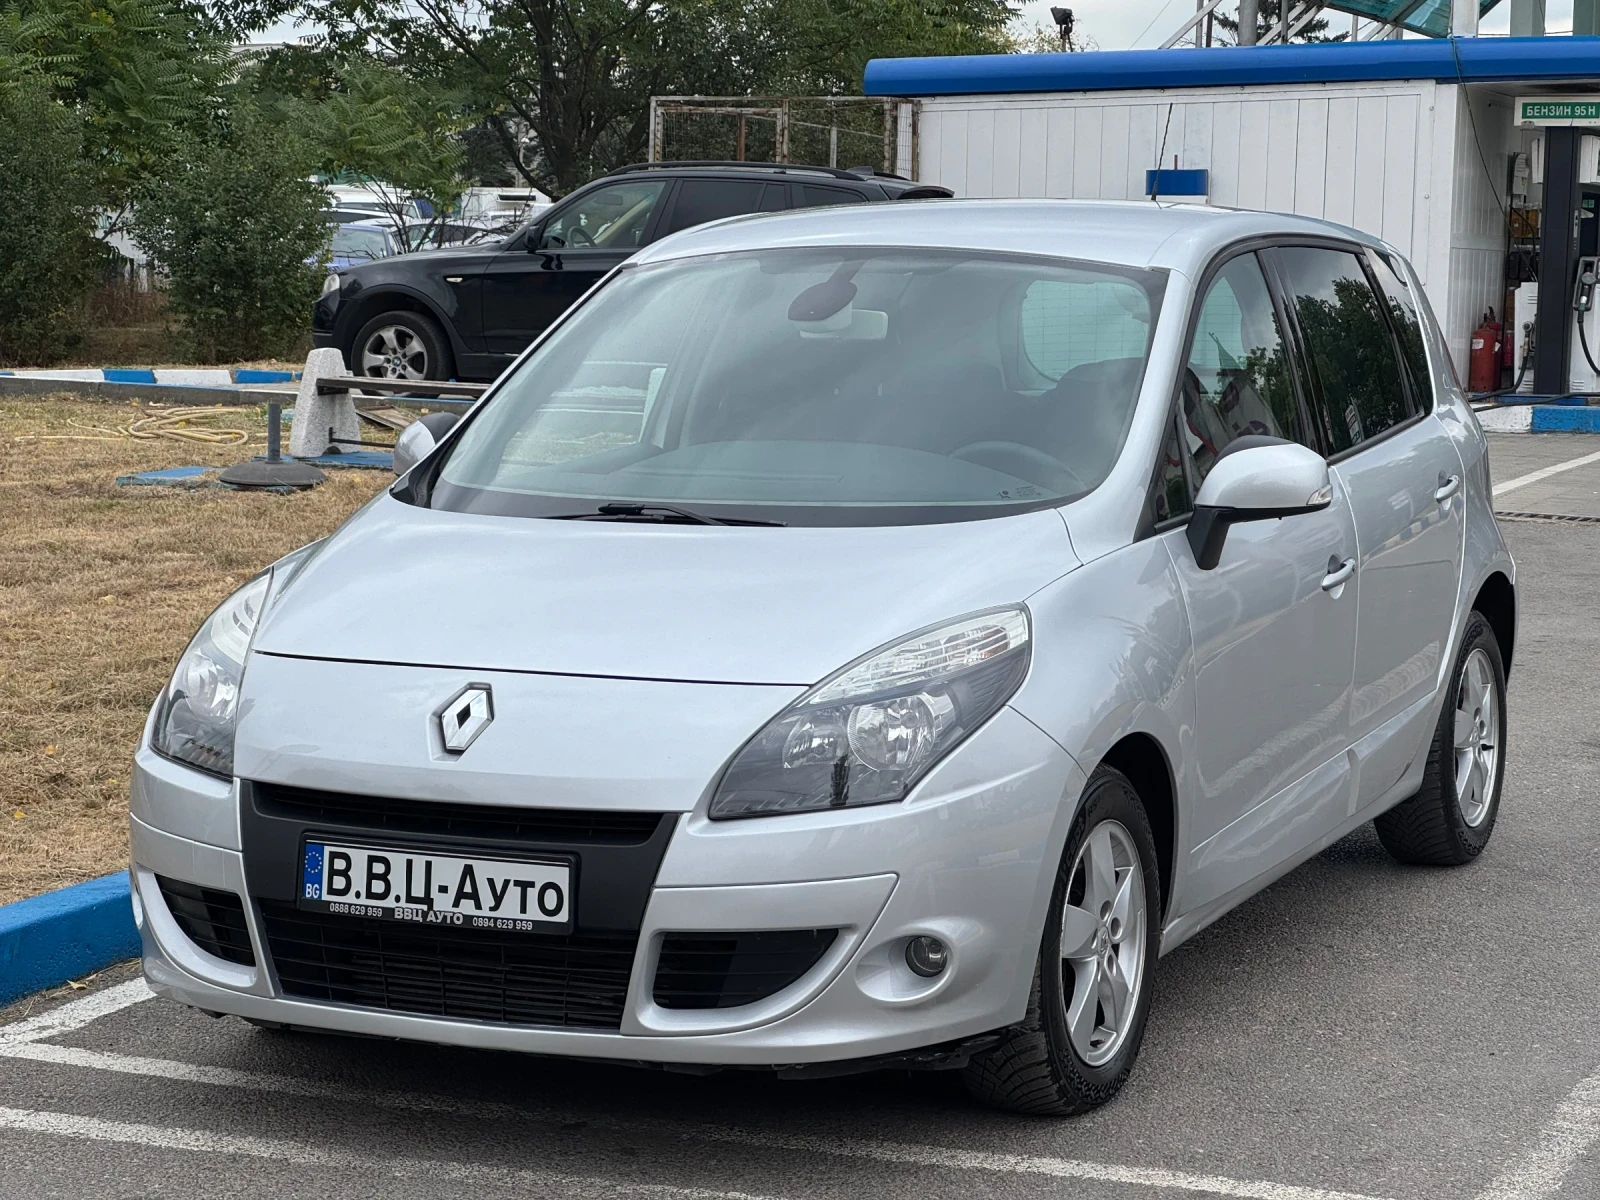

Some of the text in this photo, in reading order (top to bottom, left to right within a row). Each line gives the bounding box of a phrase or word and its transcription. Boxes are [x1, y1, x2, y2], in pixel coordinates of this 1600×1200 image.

[1526, 105, 1571, 116] БЕНЗИН
[1574, 105, 1587, 116] 95
[305, 883, 320, 899] BG
[329, 902, 383, 917] 0888 629 959
[394, 907, 464, 925] ВВЦ АУТО
[472, 917, 533, 931] 0894 629 959
